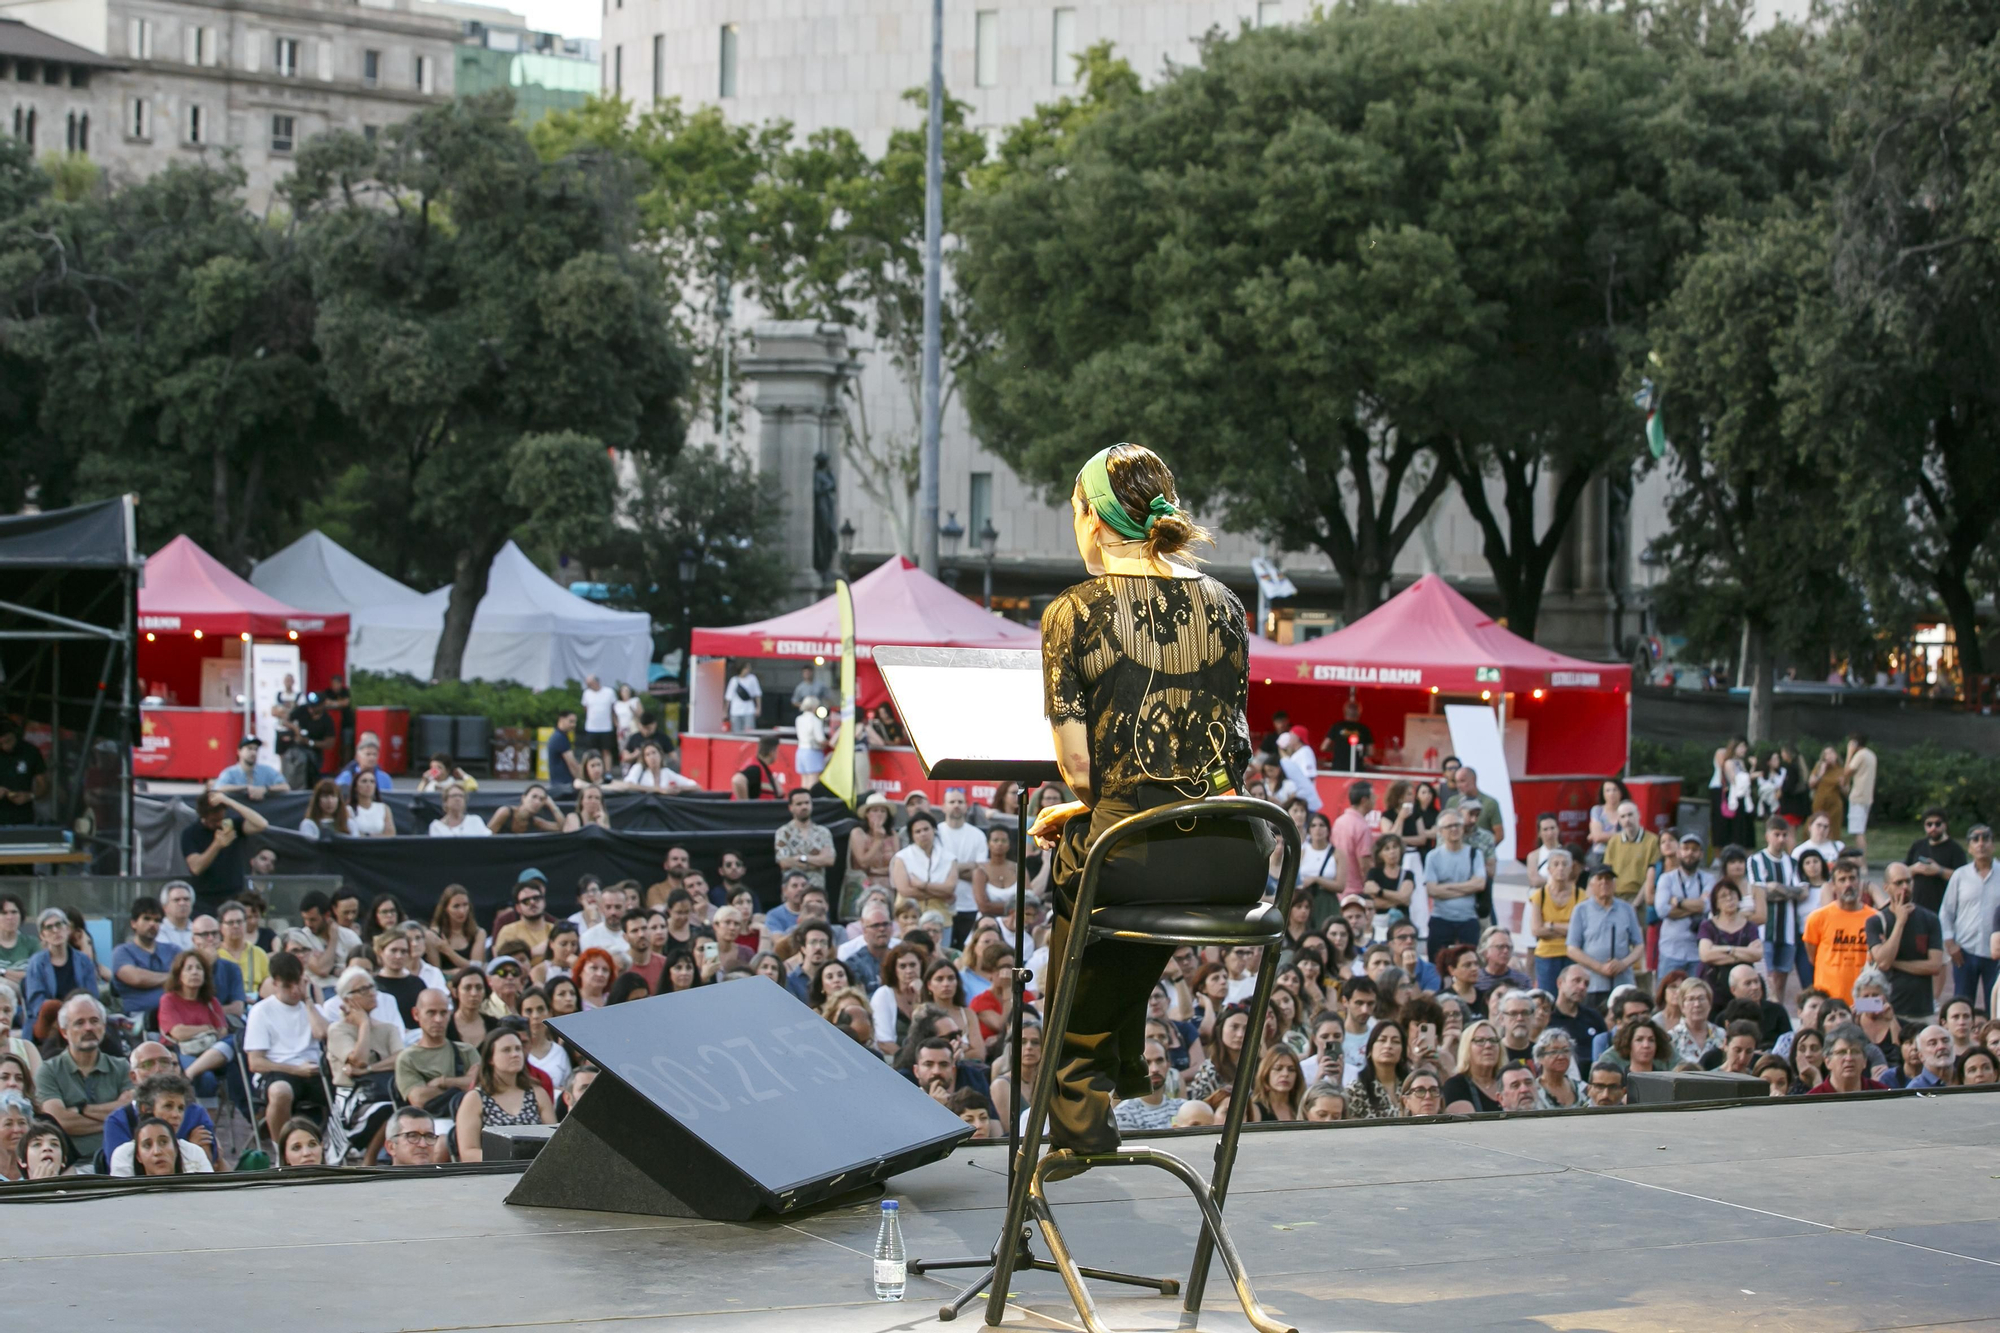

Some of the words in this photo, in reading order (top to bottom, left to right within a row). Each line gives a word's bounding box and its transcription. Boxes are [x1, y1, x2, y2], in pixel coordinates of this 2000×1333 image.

[777, 640, 832, 656] ESTRELLA
[1313, 665, 1377, 682] ESTRELLA
[1379, 668, 1422, 684] DAMM
